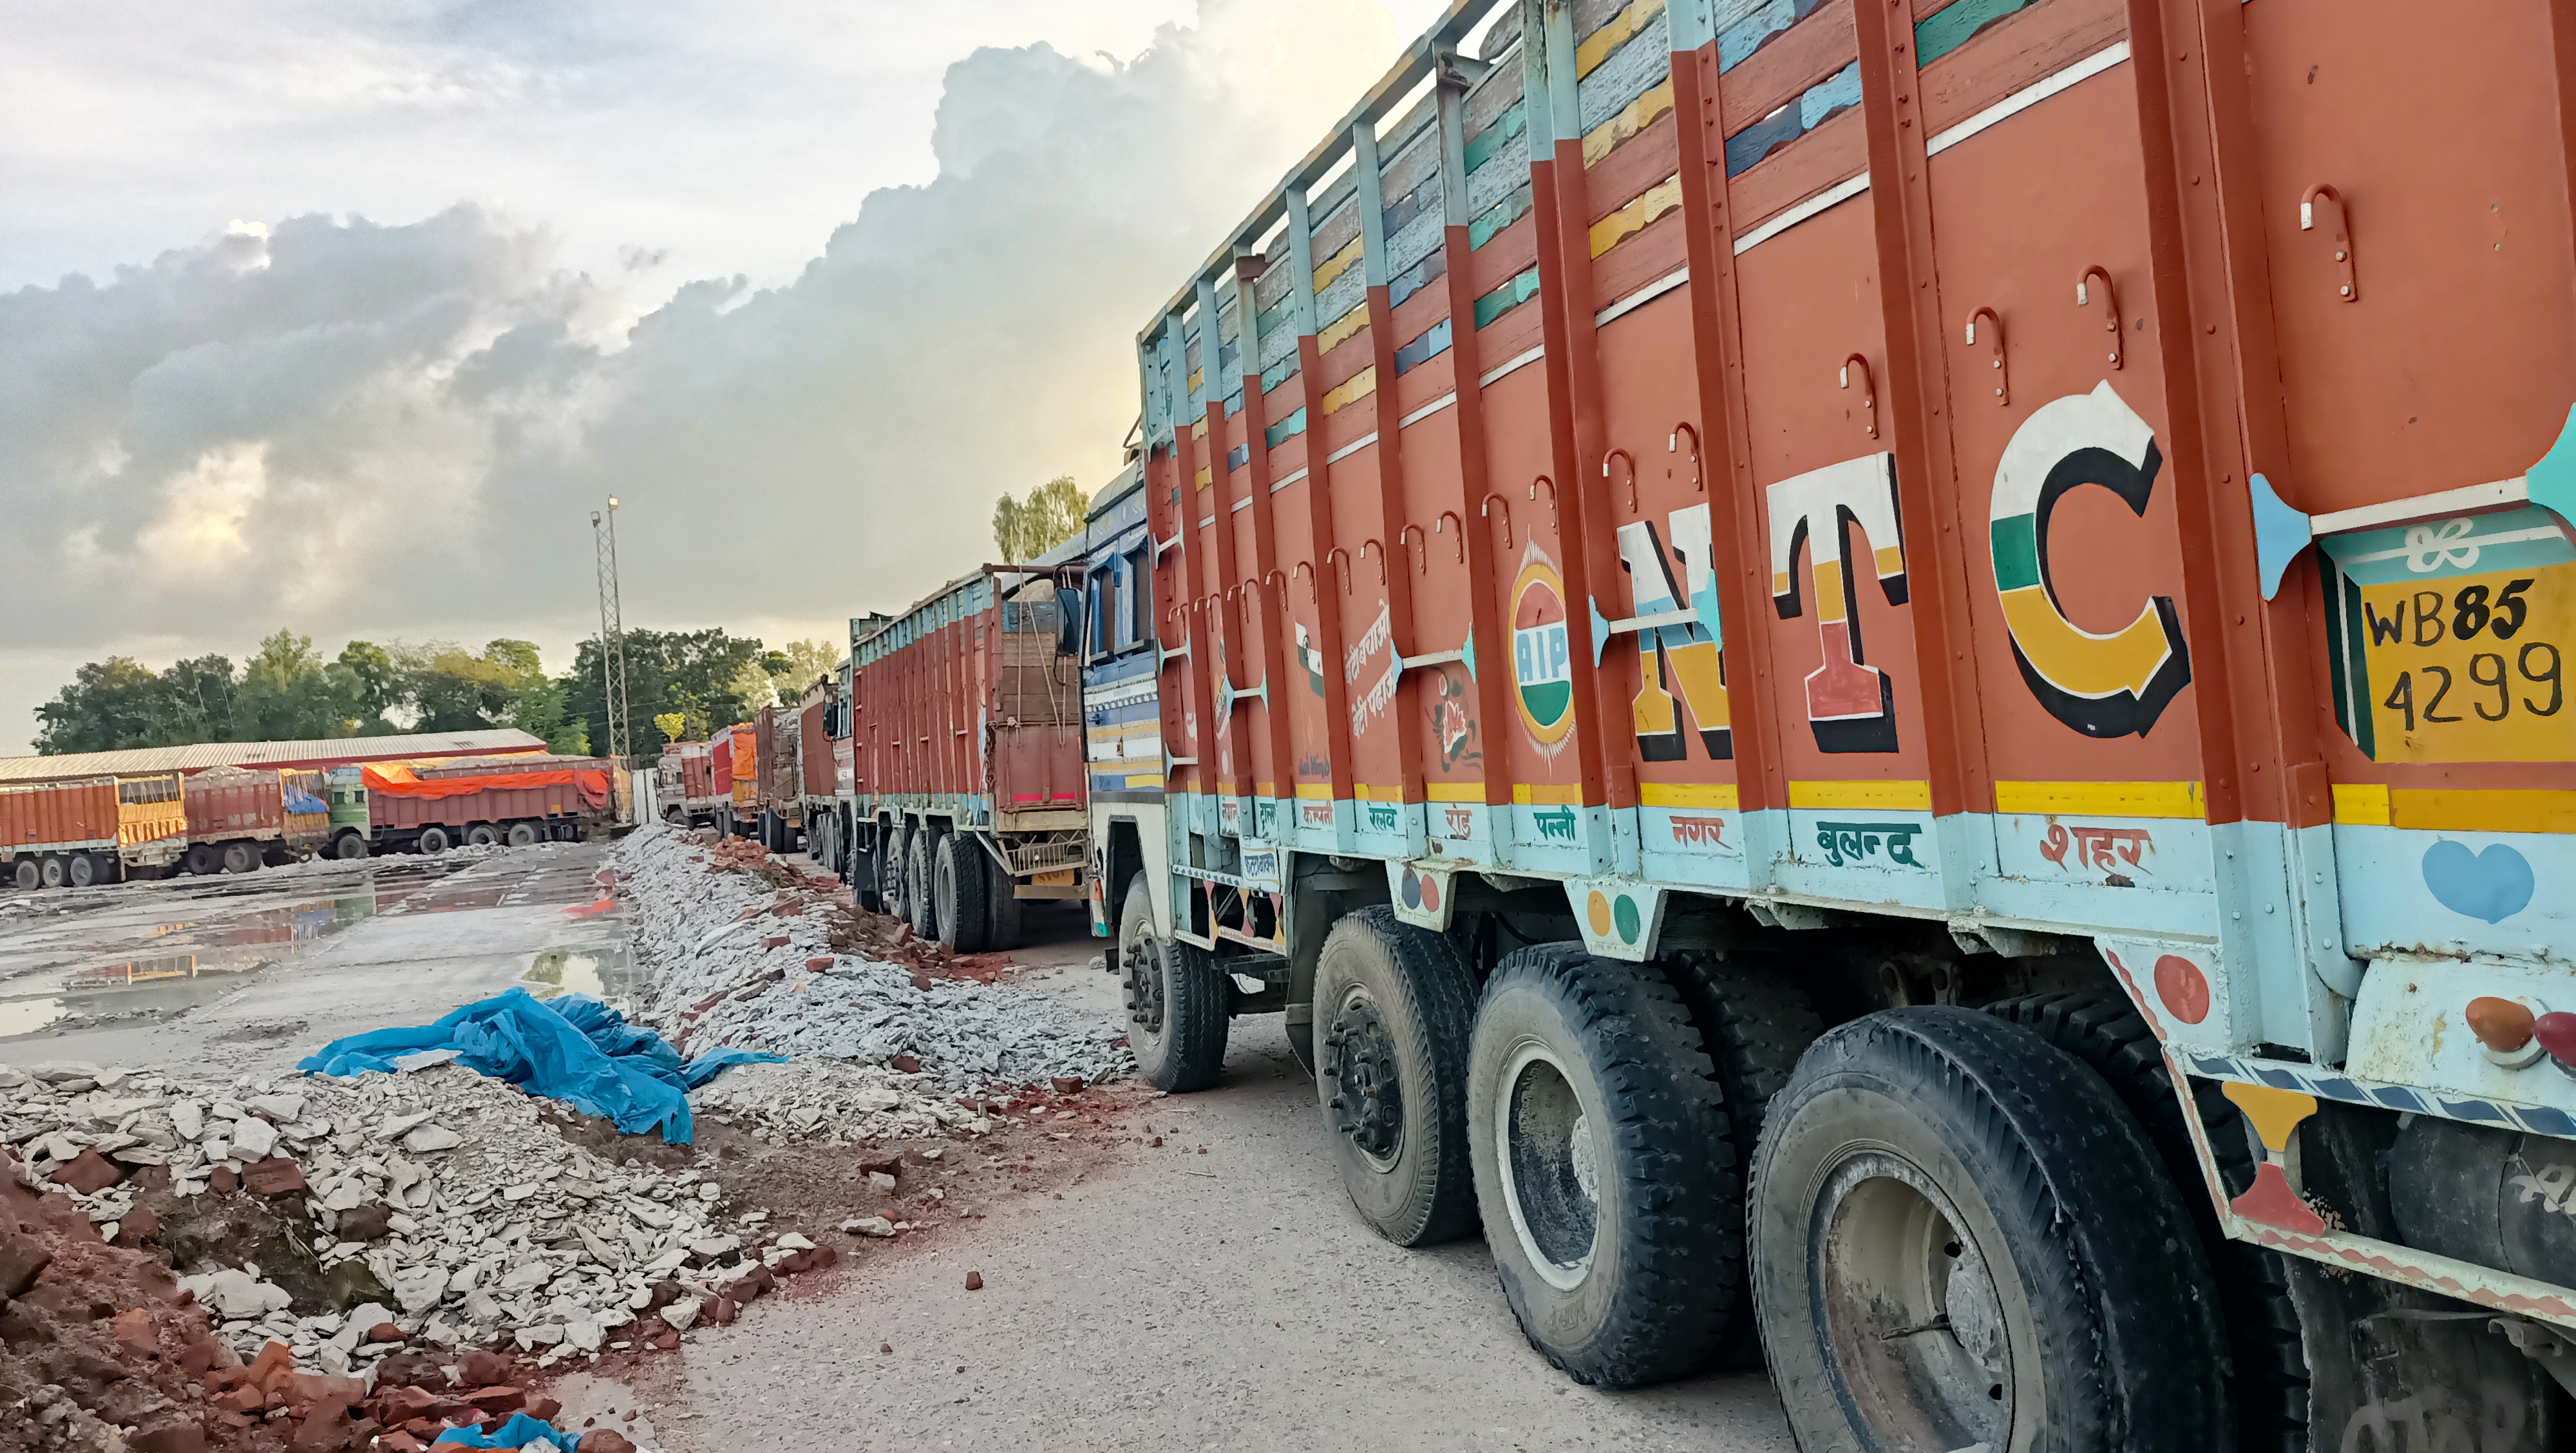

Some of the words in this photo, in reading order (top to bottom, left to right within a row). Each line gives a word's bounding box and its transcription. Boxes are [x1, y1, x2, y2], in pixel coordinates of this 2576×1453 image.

[1517, 626, 1567, 684] AIP
[2383, 641, 2563, 732] 4299
[1366, 801, 1398, 831] रेलवे
[1444, 802, 1473, 840] रोड
[1669, 815, 1733, 850] नगर
[1815, 821, 1924, 869] बुलन्द
[2040, 823, 2154, 876] शहर
